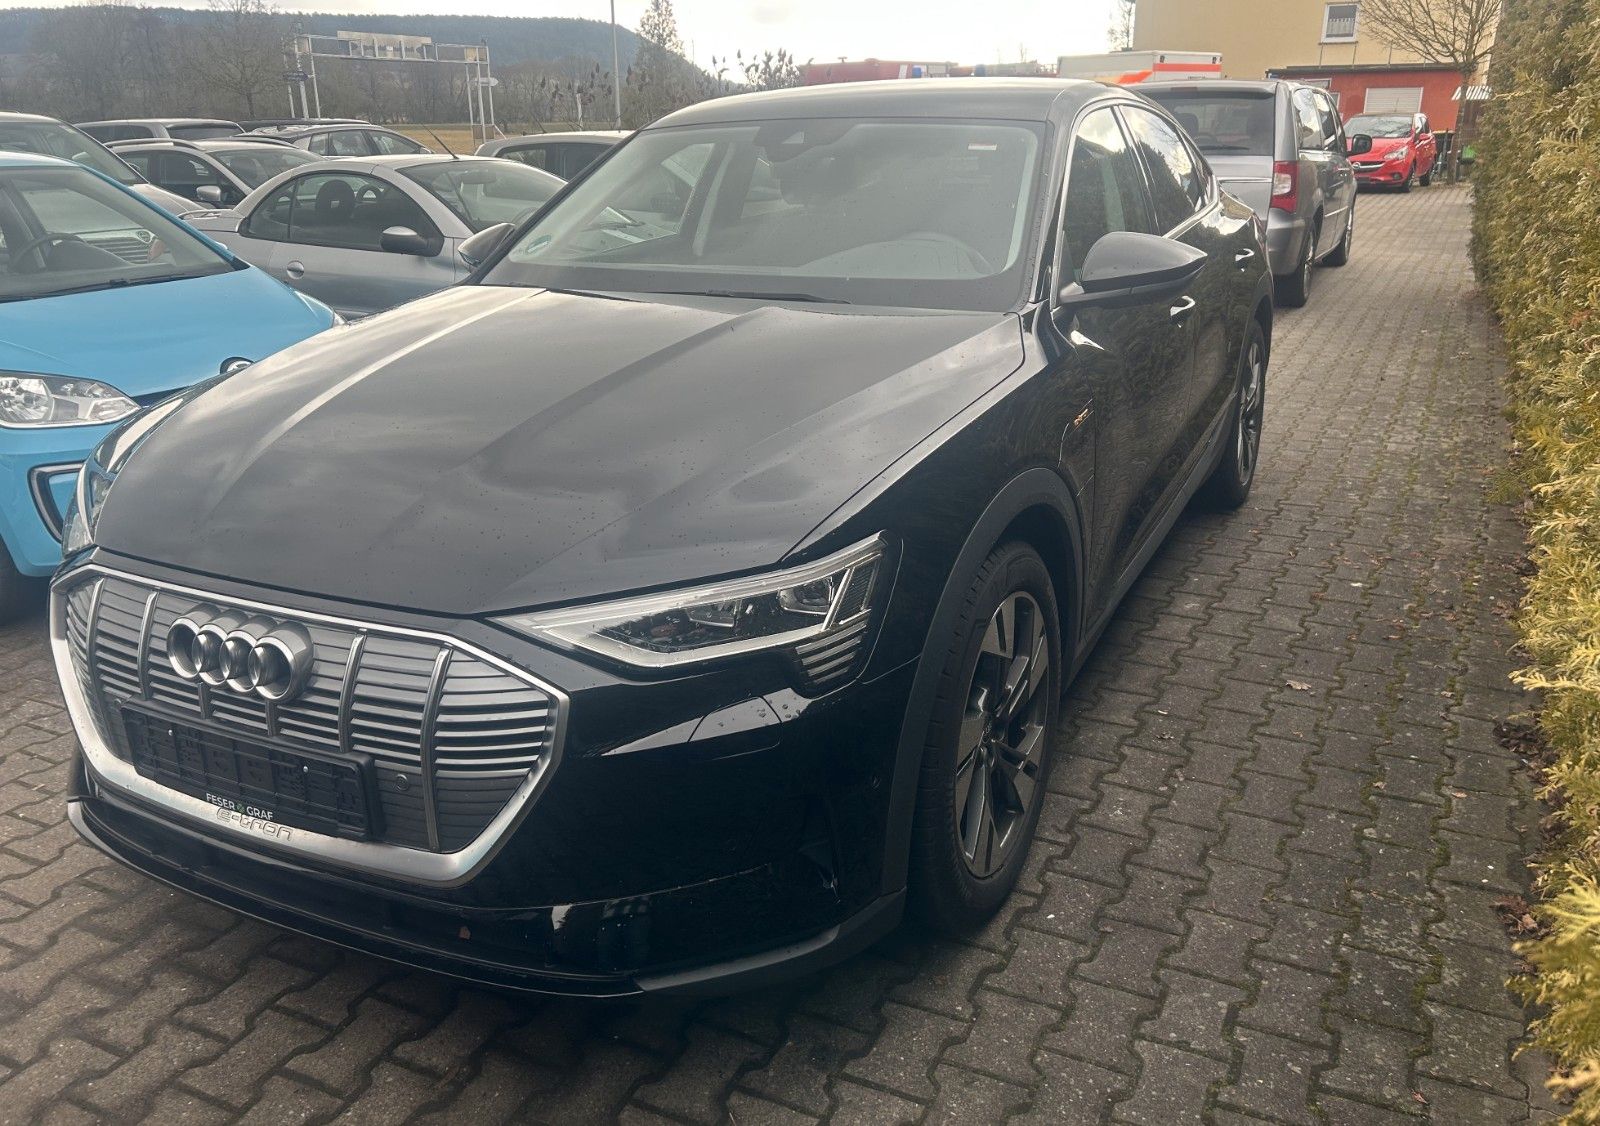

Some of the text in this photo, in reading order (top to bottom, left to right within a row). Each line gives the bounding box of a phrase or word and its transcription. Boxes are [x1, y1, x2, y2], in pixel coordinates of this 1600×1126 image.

[206, 793, 273, 820] FESER GRAF
[216, 807, 293, 841] e-tron
